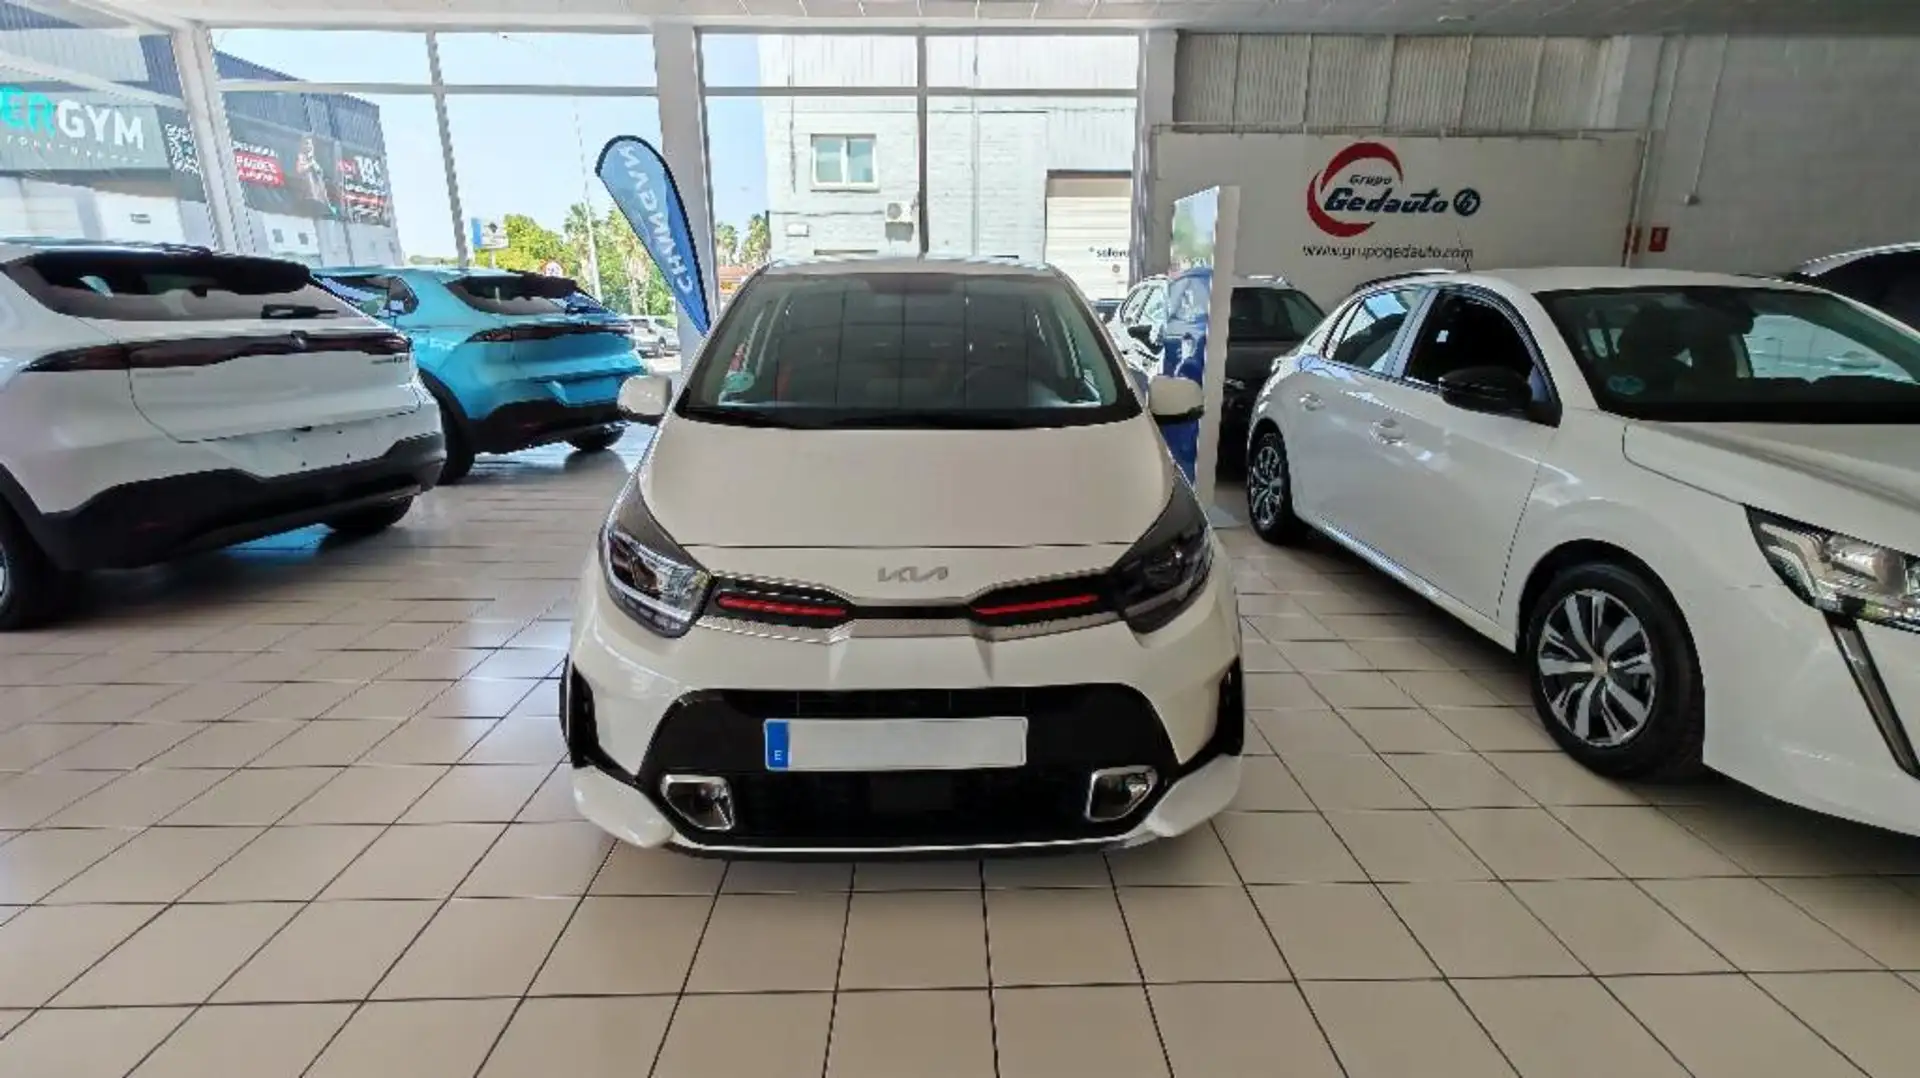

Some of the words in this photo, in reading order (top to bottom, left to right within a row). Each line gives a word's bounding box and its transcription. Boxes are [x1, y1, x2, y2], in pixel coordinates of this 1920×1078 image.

[1349, 174, 1393, 186] Grupo
[1324, 188, 1449, 214] Gedauto
[1303, 244, 1473, 259] www.grupogedauto.com
[878, 566, 949, 583] KIA
[774, 749, 782, 761] E
